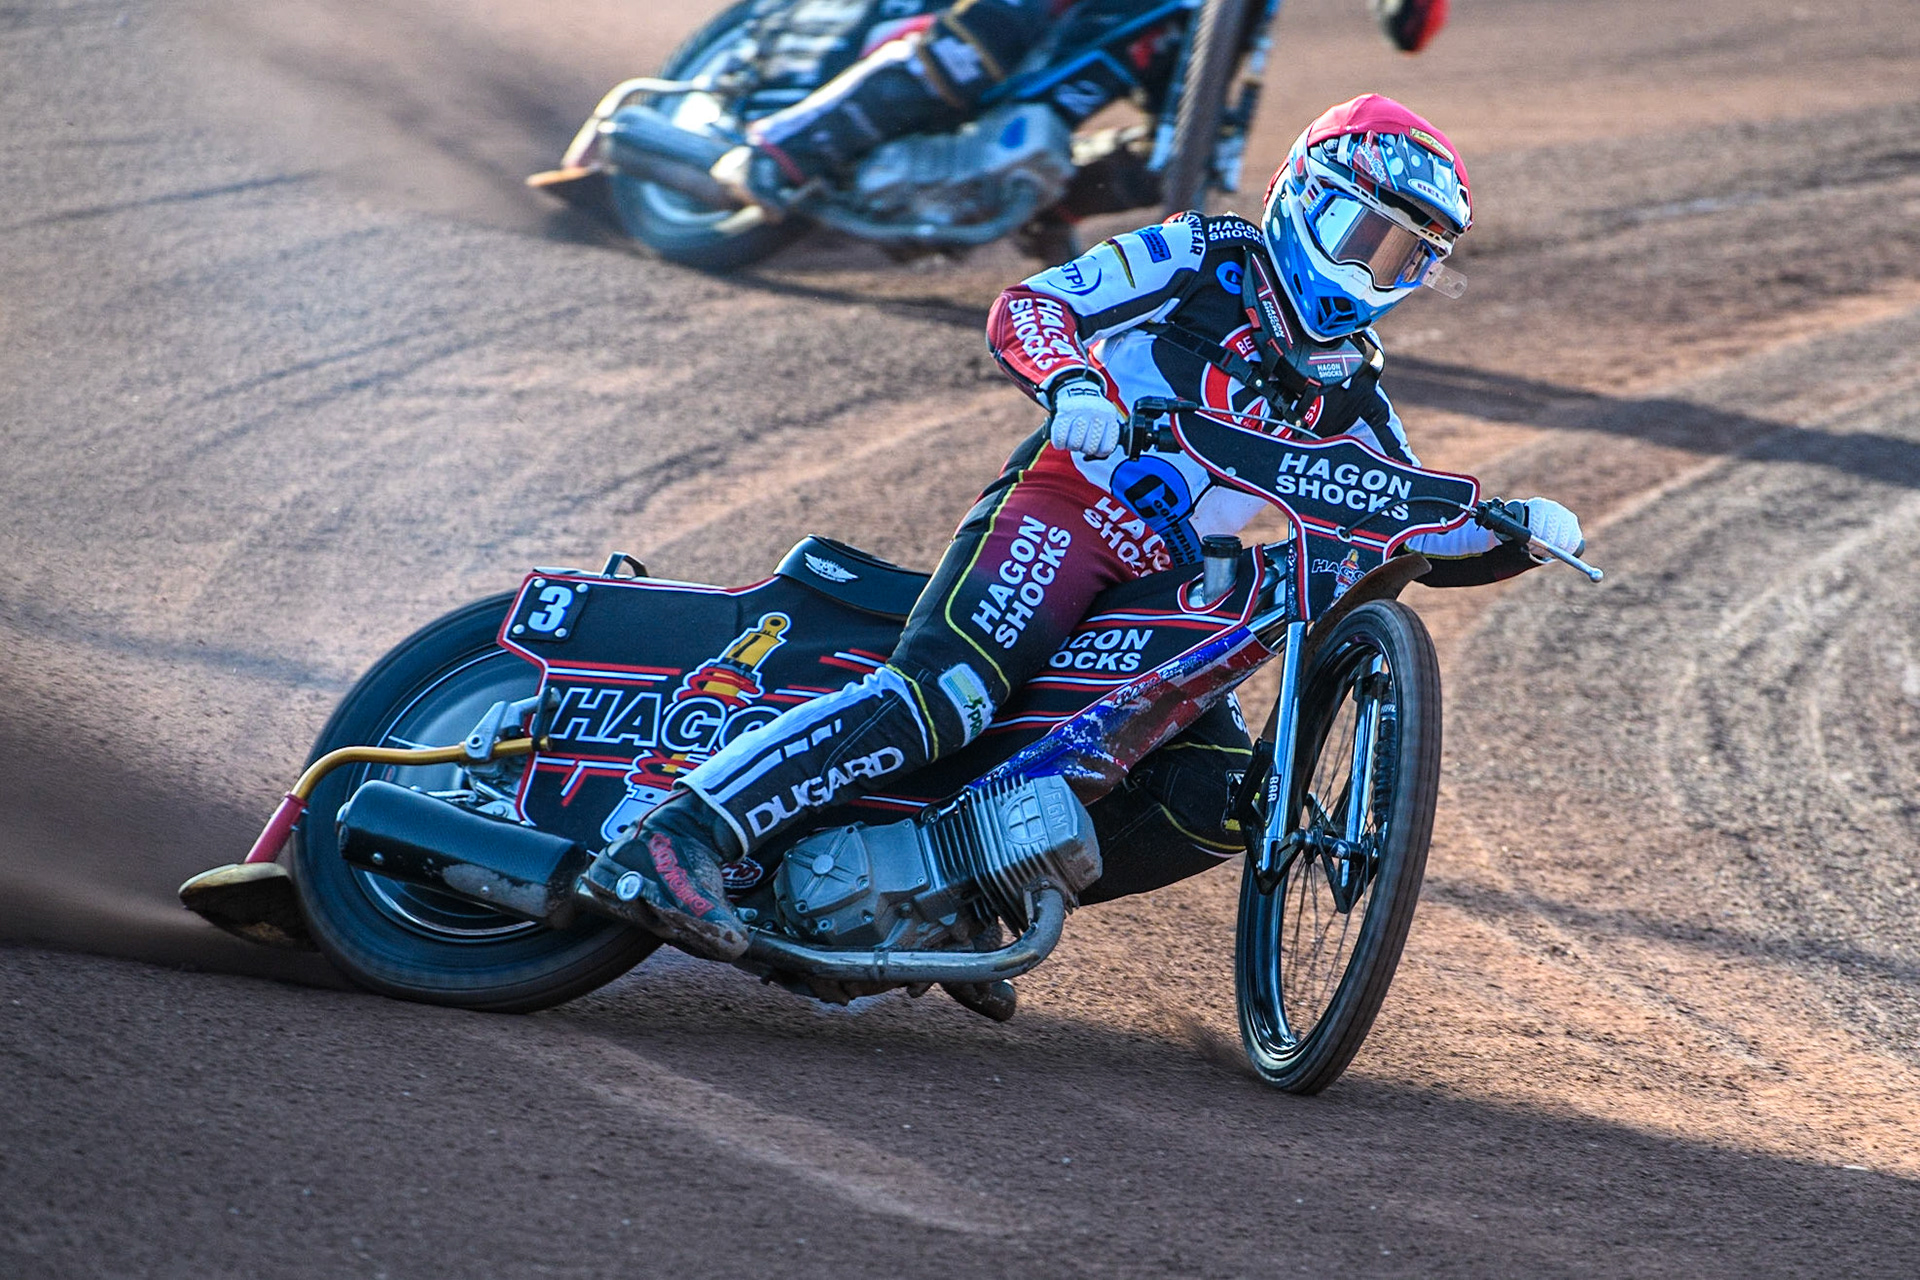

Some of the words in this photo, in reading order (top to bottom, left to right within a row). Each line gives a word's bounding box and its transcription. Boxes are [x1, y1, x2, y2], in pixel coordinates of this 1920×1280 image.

[1008, 298, 1060, 371] SHOCKS
[1317, 363, 1341, 373] HAGON
[1319, 369, 1343, 378] SHOCKS
[1275, 474, 1410, 521] SHOCKS
[1278, 452, 1412, 500] HAGON
[971, 514, 1047, 635] HAGON
[994, 526, 1072, 649] SHOCKS
[527, 585, 574, 634] 3
[744, 745, 905, 839] DUGARD
